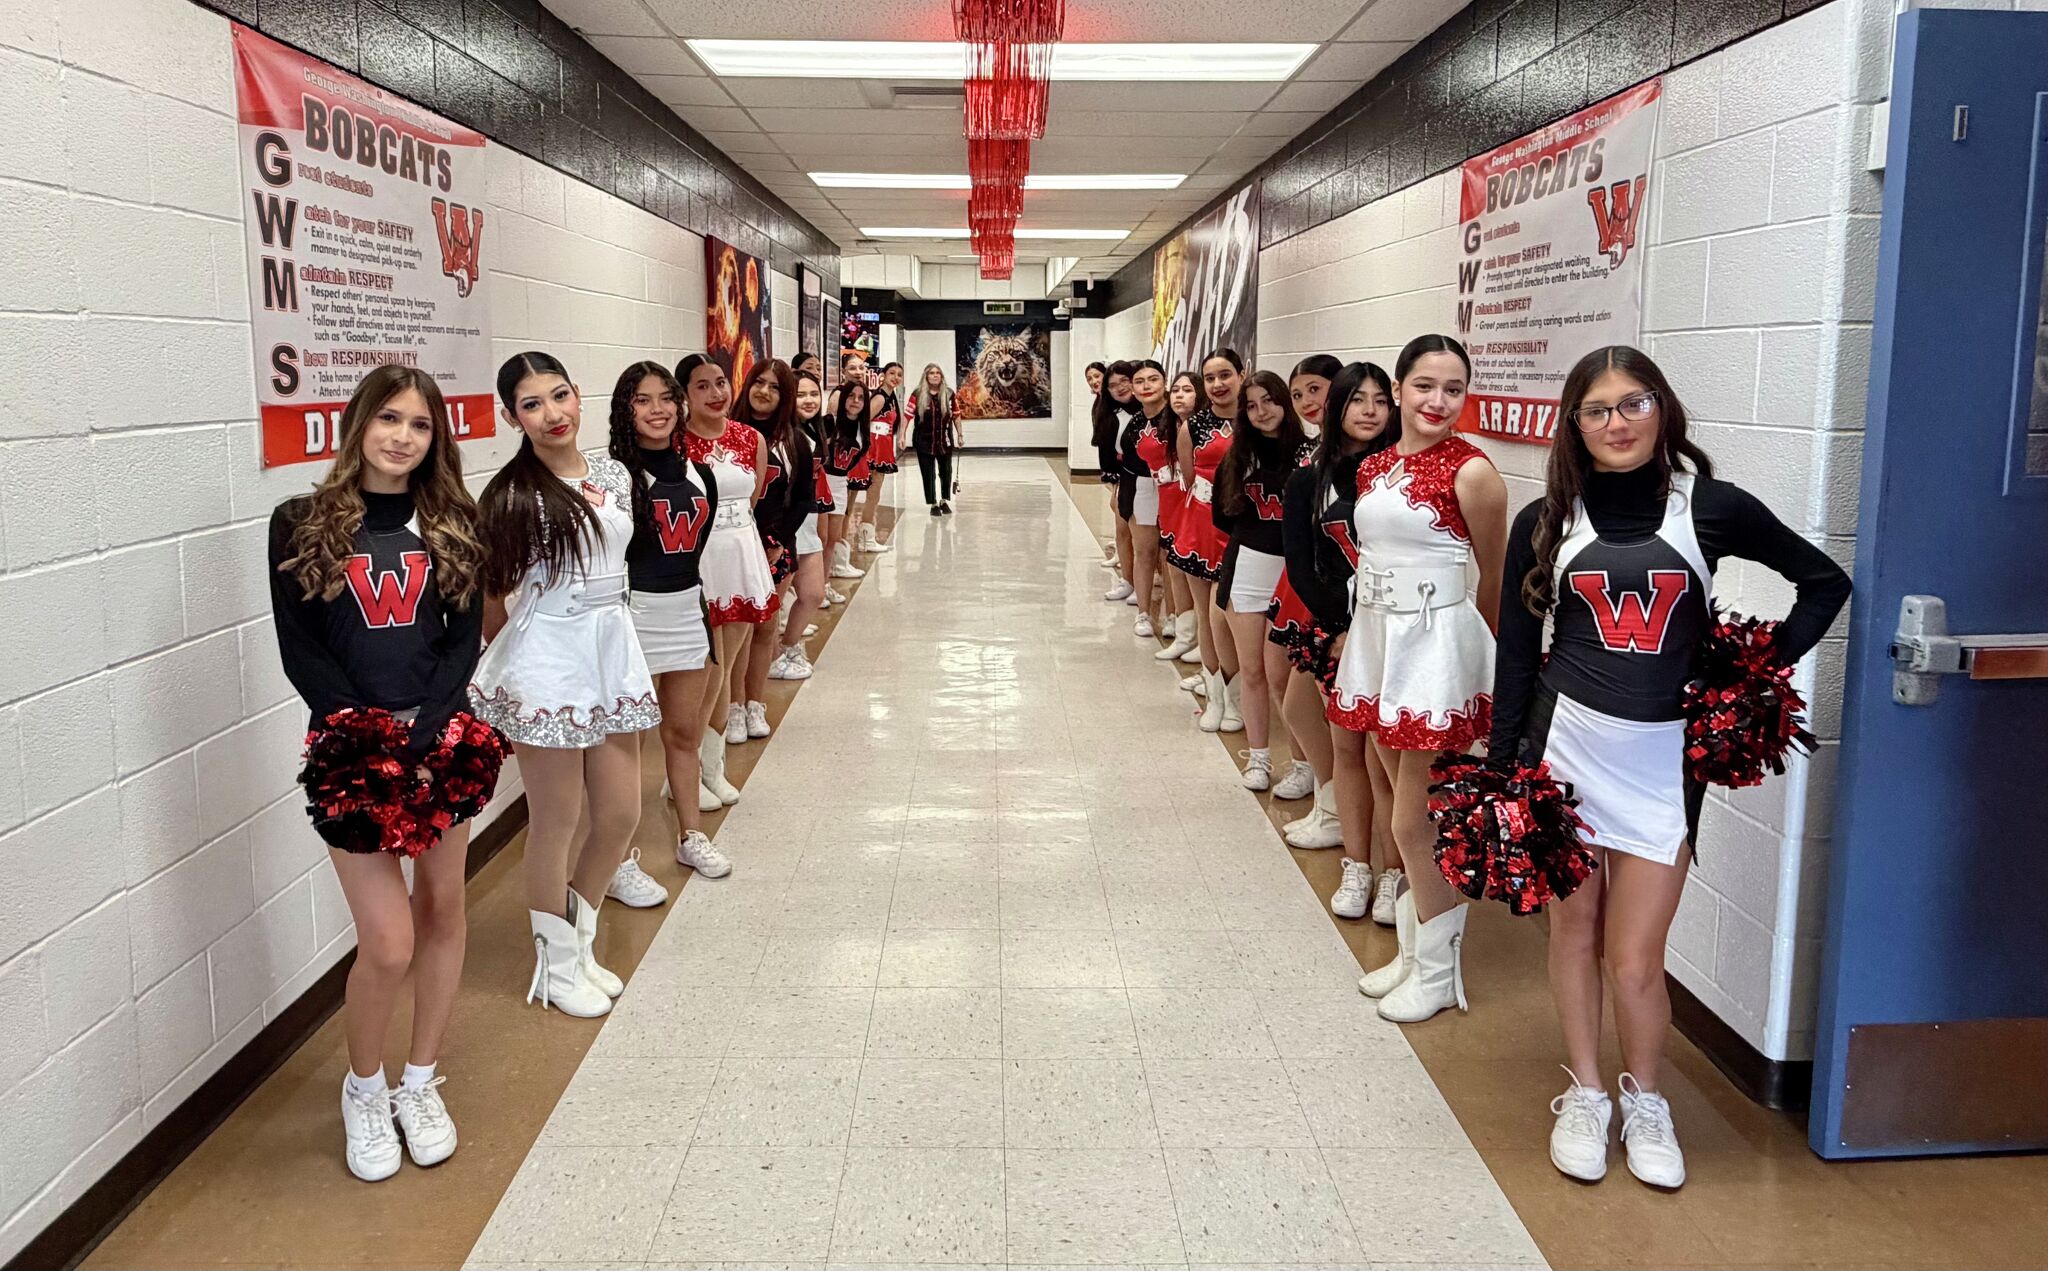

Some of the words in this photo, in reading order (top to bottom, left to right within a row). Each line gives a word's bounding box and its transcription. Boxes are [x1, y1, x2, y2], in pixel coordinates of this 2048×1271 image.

[304, 66, 340, 97] George
[1584, 108, 1613, 132] School
[302, 92, 452, 193] BOBCATS
[255, 130, 293, 188] G
[1485, 136, 1607, 216] BOBCATS
[252, 189, 299, 251] W
[377, 219, 414, 242] SAFETY
[311, 225, 324, 239] Exit
[326, 229, 333, 241] in
[340, 234, 358, 247] quick,
[392, 244, 403, 255] and
[1463, 221, 1481, 255] G
[311, 243, 339, 256] manner
[341, 248, 347, 257] to
[348, 248, 380, 264] designated
[1458, 259, 1482, 295] W
[1522, 241, 1551, 262] SAFETY
[1565, 255, 1590, 268] waiting
[260, 255, 299, 313] M
[347, 268, 394, 291] RESPECT
[1551, 273, 1568, 284] enter
[1570, 268, 1580, 280] the
[311, 285, 341, 300] Respect
[365, 293, 389, 304] personal
[390, 296, 406, 307] space
[407, 297, 414, 309] by
[414, 297, 436, 311] keeping
[312, 302, 330, 315] your
[331, 301, 355, 315] hands,
[371, 307, 383, 316] and
[403, 309, 409, 318] to
[312, 315, 337, 328] Follow
[339, 316, 355, 328] staff
[356, 319, 384, 331] directives
[385, 321, 396, 331] and
[407, 323, 421, 335] good
[1457, 299, 1473, 335] M
[1503, 296, 1532, 313] RESPECT
[1480, 320, 1495, 330] Greet
[1543, 314, 1562, 328] caring
[1564, 312, 1582, 324] words
[1583, 311, 1595, 322] and
[314, 330, 330, 341] such
[331, 333, 340, 341] as
[1486, 339, 1549, 356] RESPONSIBILITY
[271, 343, 300, 397] S
[330, 348, 418, 369] RESPONSIBILITY
[318, 370, 334, 383] Take
[335, 370, 353, 383] home
[1481, 370, 1505, 381] prepared
[1491, 359, 1497, 368] at
[1498, 358, 1516, 368] school
[319, 386, 341, 397] Attend
[1479, 400, 1561, 439] ARRIV
[652, 497, 710, 554] W
[343, 551, 432, 629] W
[1569, 570, 1689, 655] W
